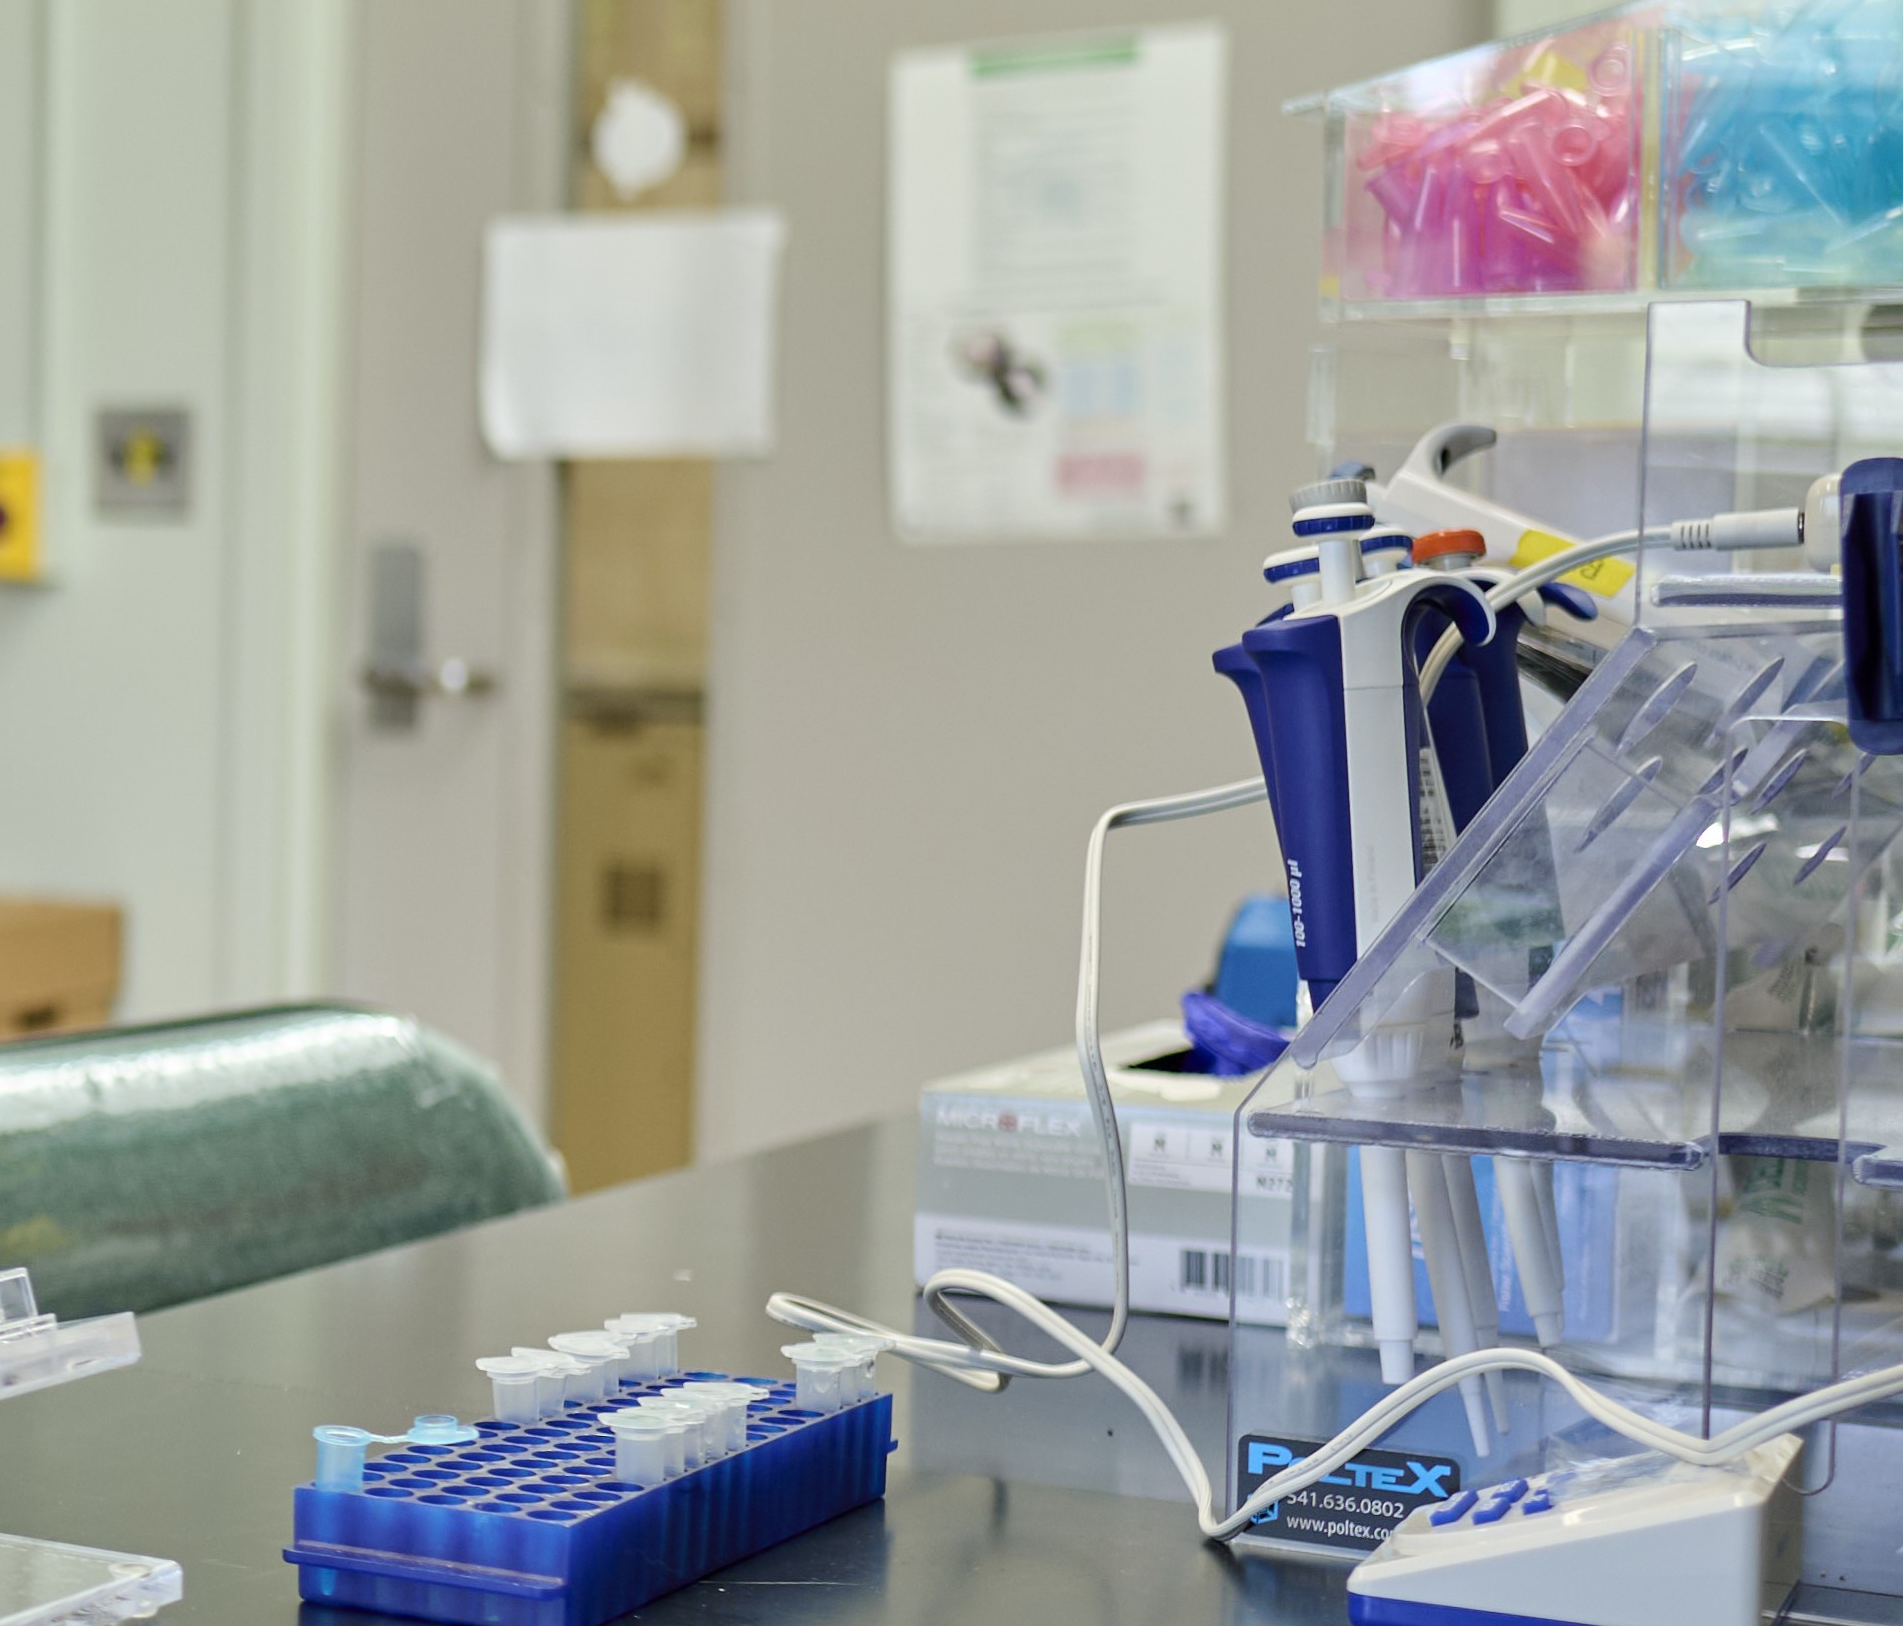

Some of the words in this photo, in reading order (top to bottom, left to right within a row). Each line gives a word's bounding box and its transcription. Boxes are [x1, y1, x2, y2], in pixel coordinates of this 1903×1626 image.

[1290, 878, 1306, 948] 100-1000
[937, 1107, 1081, 1138] MICROFLEX
[1248, 1442, 1451, 1498] PLTEX
[1287, 1491, 1404, 1519] 541.636.0802
[1286, 1515, 1395, 1542] www.poltex.co
